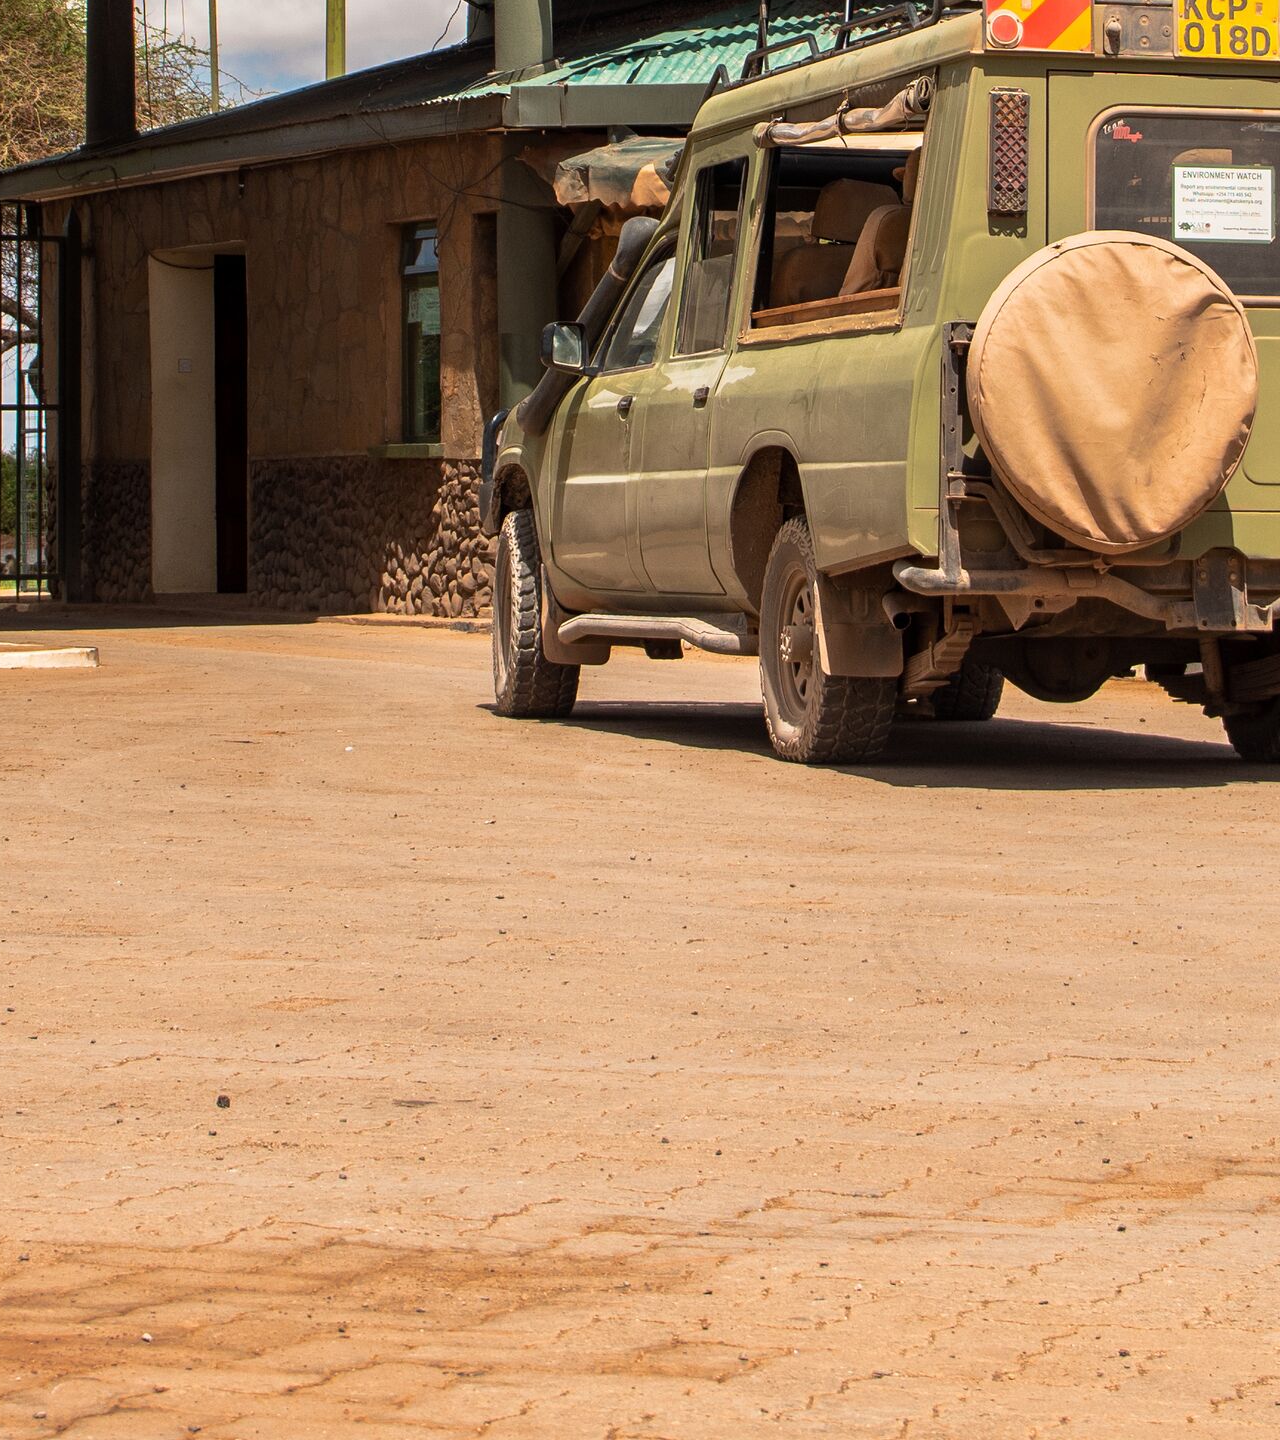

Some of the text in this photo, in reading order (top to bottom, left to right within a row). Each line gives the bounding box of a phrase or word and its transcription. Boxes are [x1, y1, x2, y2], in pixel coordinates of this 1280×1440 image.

[1184, 22, 1271, 56] 018D
[1182, 170, 1262, 180] ENVIRONMENT WATCH
